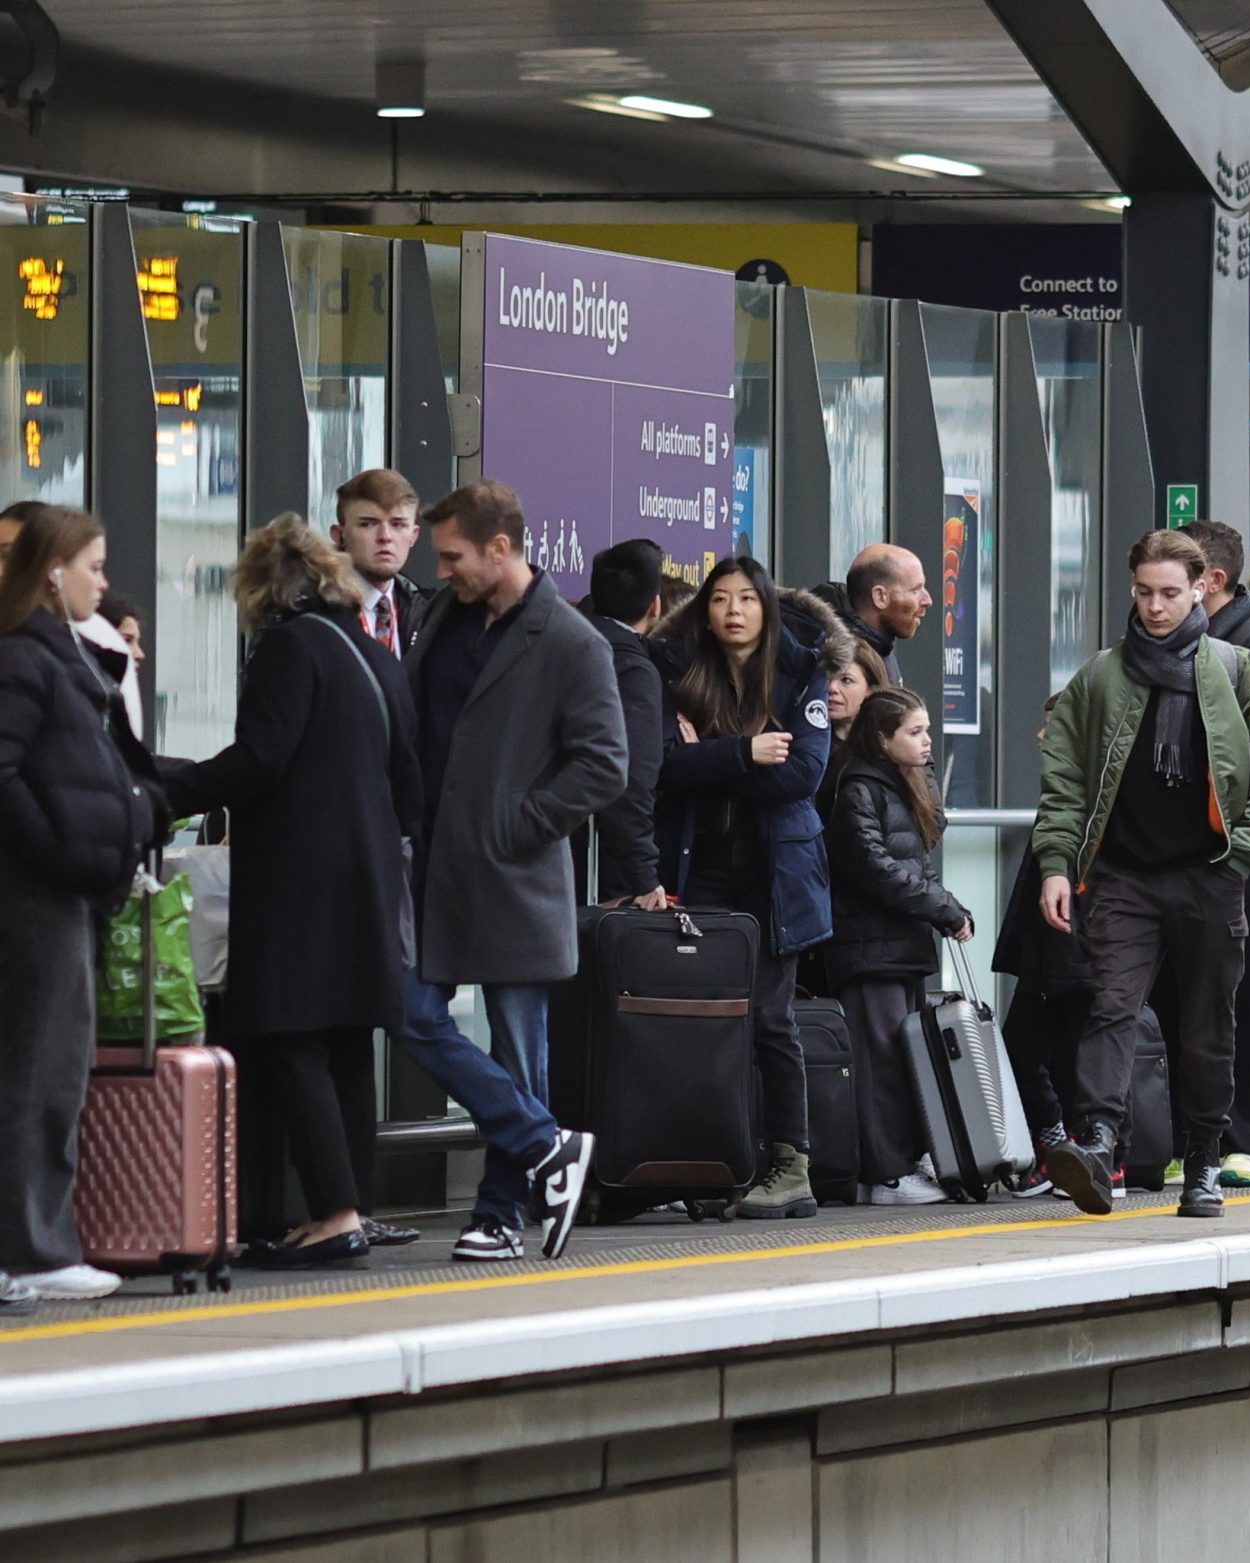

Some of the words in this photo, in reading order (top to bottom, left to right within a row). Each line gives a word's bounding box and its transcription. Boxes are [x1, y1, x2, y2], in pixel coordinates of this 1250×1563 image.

[1020, 275, 1094, 293] Connect
[1099, 277, 1118, 292] to
[499, 267, 567, 334] London
[573, 278, 629, 355] Bridge
[641, 421, 654, 451] All
[656, 422, 701, 460] platforms
[640, 486, 700, 527] Underground
[683, 559, 700, 587] out
